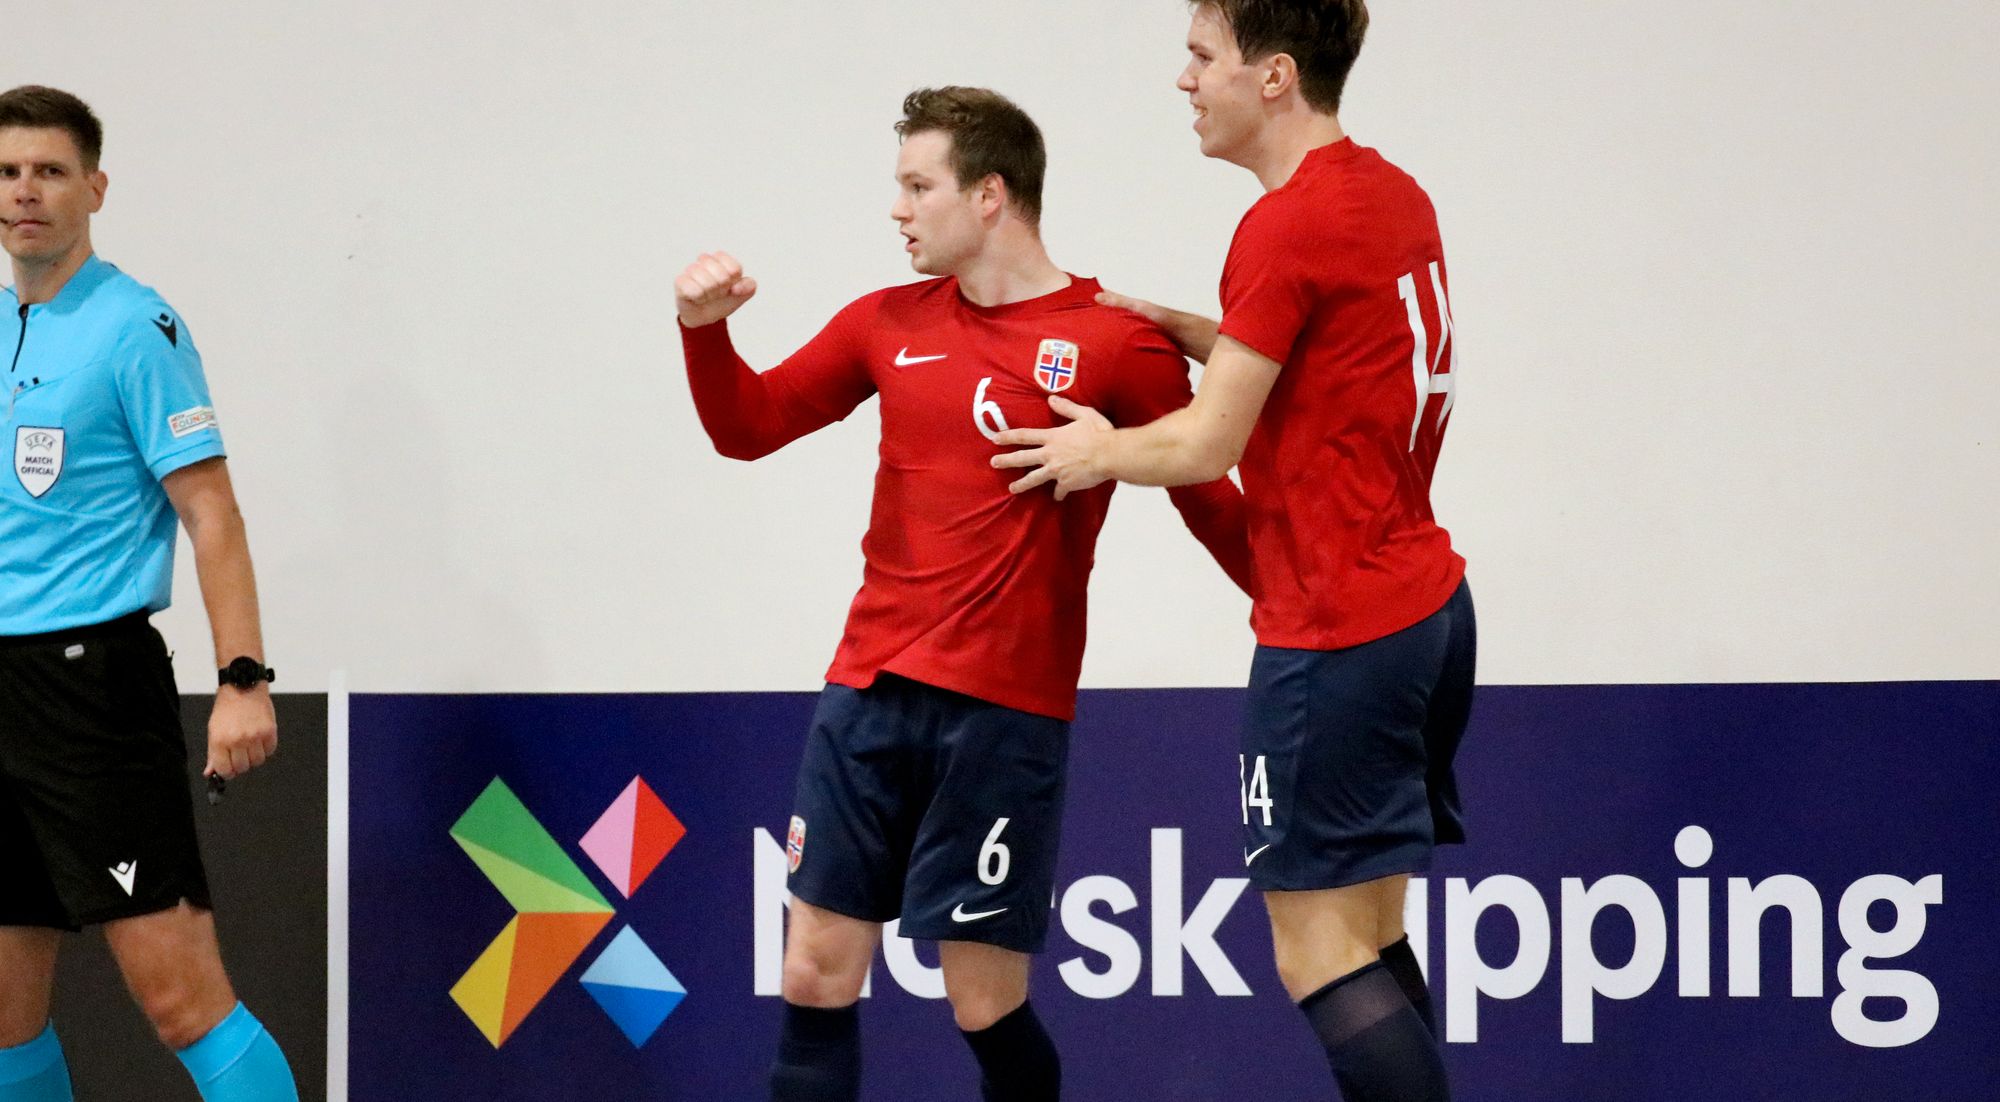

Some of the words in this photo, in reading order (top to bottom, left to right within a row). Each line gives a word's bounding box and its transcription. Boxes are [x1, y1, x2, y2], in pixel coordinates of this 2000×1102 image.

[973, 377, 1009, 441] 6
[25, 456, 53, 464] MATCH
[26, 435, 53, 448] UEFA
[21, 466, 54, 475] OFFICIAL
[977, 818, 1010, 885] 6
[1403, 825, 1942, 1048] pping
